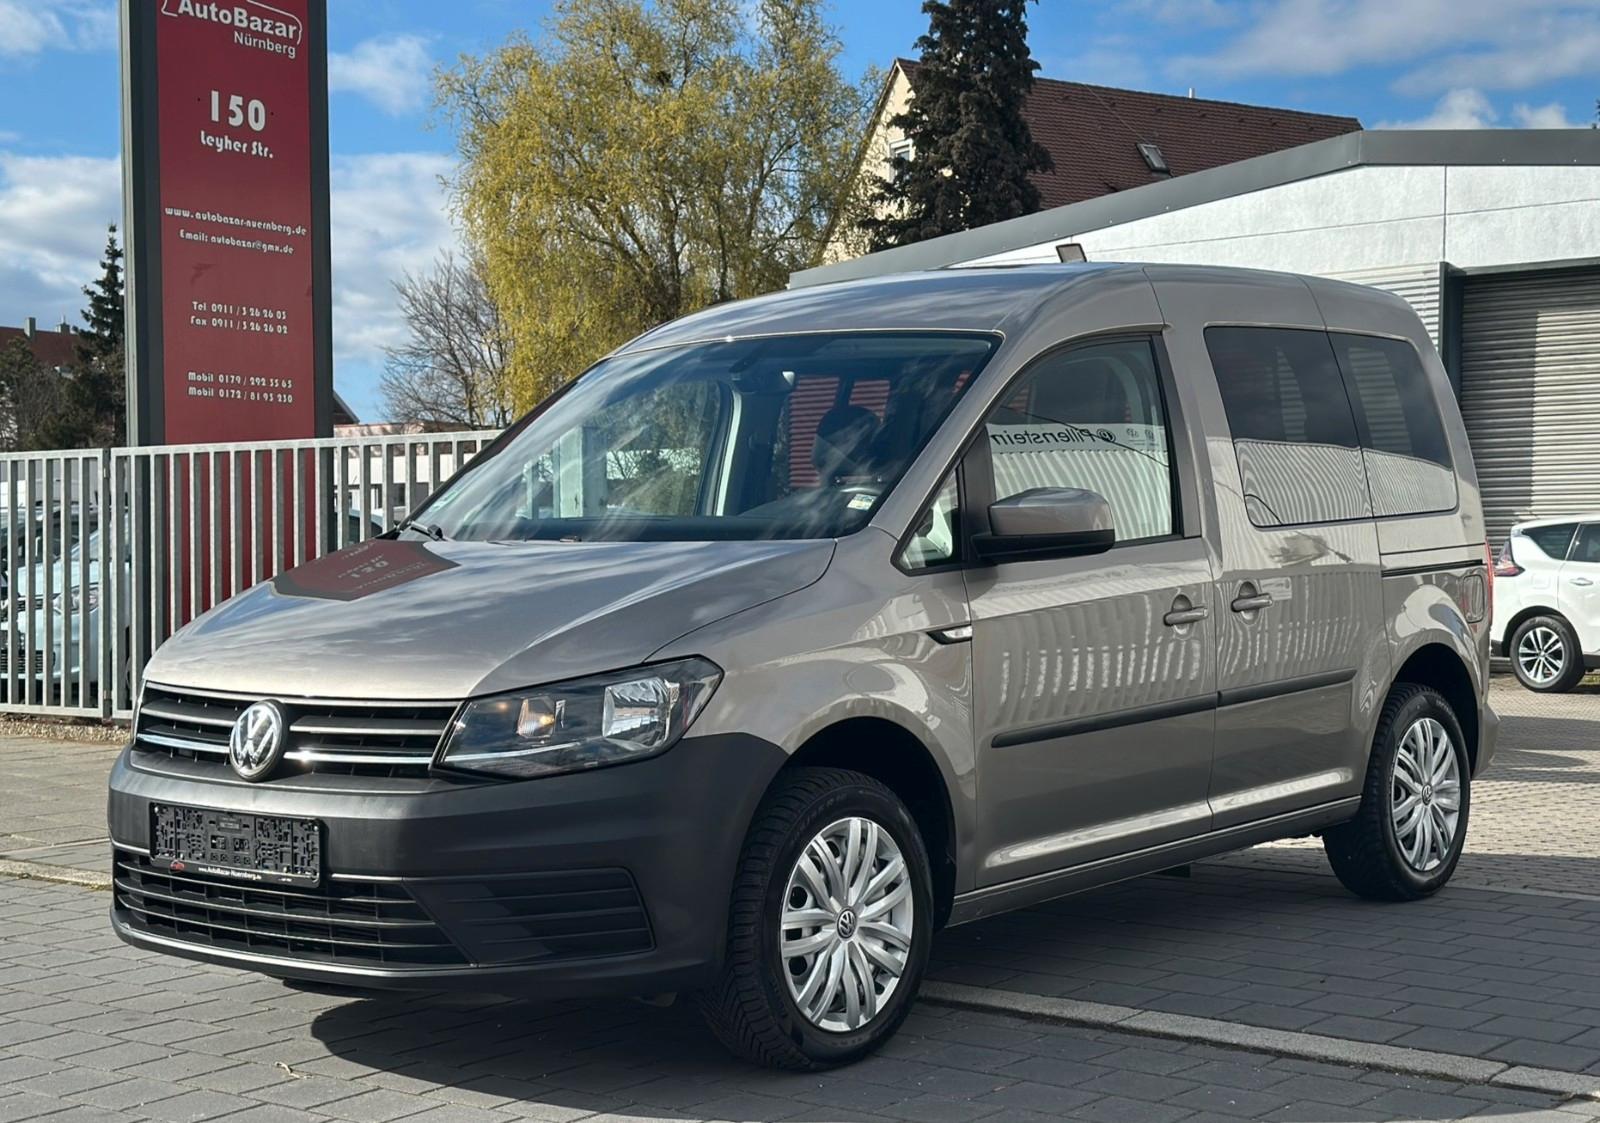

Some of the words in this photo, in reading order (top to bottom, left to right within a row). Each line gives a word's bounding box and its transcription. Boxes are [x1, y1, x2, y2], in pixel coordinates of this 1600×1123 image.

[178, 0, 297, 39] AutoBazar
[234, 31, 296, 59] Nürnberg
[211, 90, 266, 131] 150
[201, 130, 247, 153] Leyher
[252, 141, 274, 158] Str.
[165, 207, 307, 236] www.autobazar-nuernberg.de
[180, 229, 208, 242] Email:
[211, 236, 294, 254] autobazar@gmx.de
[192, 301, 206, 311] Tel
[211, 303, 233, 314] 0911
[190, 315, 207, 326] Fax
[211, 318, 233, 328] 0911
[188, 371, 214, 382] Mobil
[218, 374, 241, 384] 0179
[188, 386, 214, 397] Mobil
[218, 388, 241, 399] 0172
